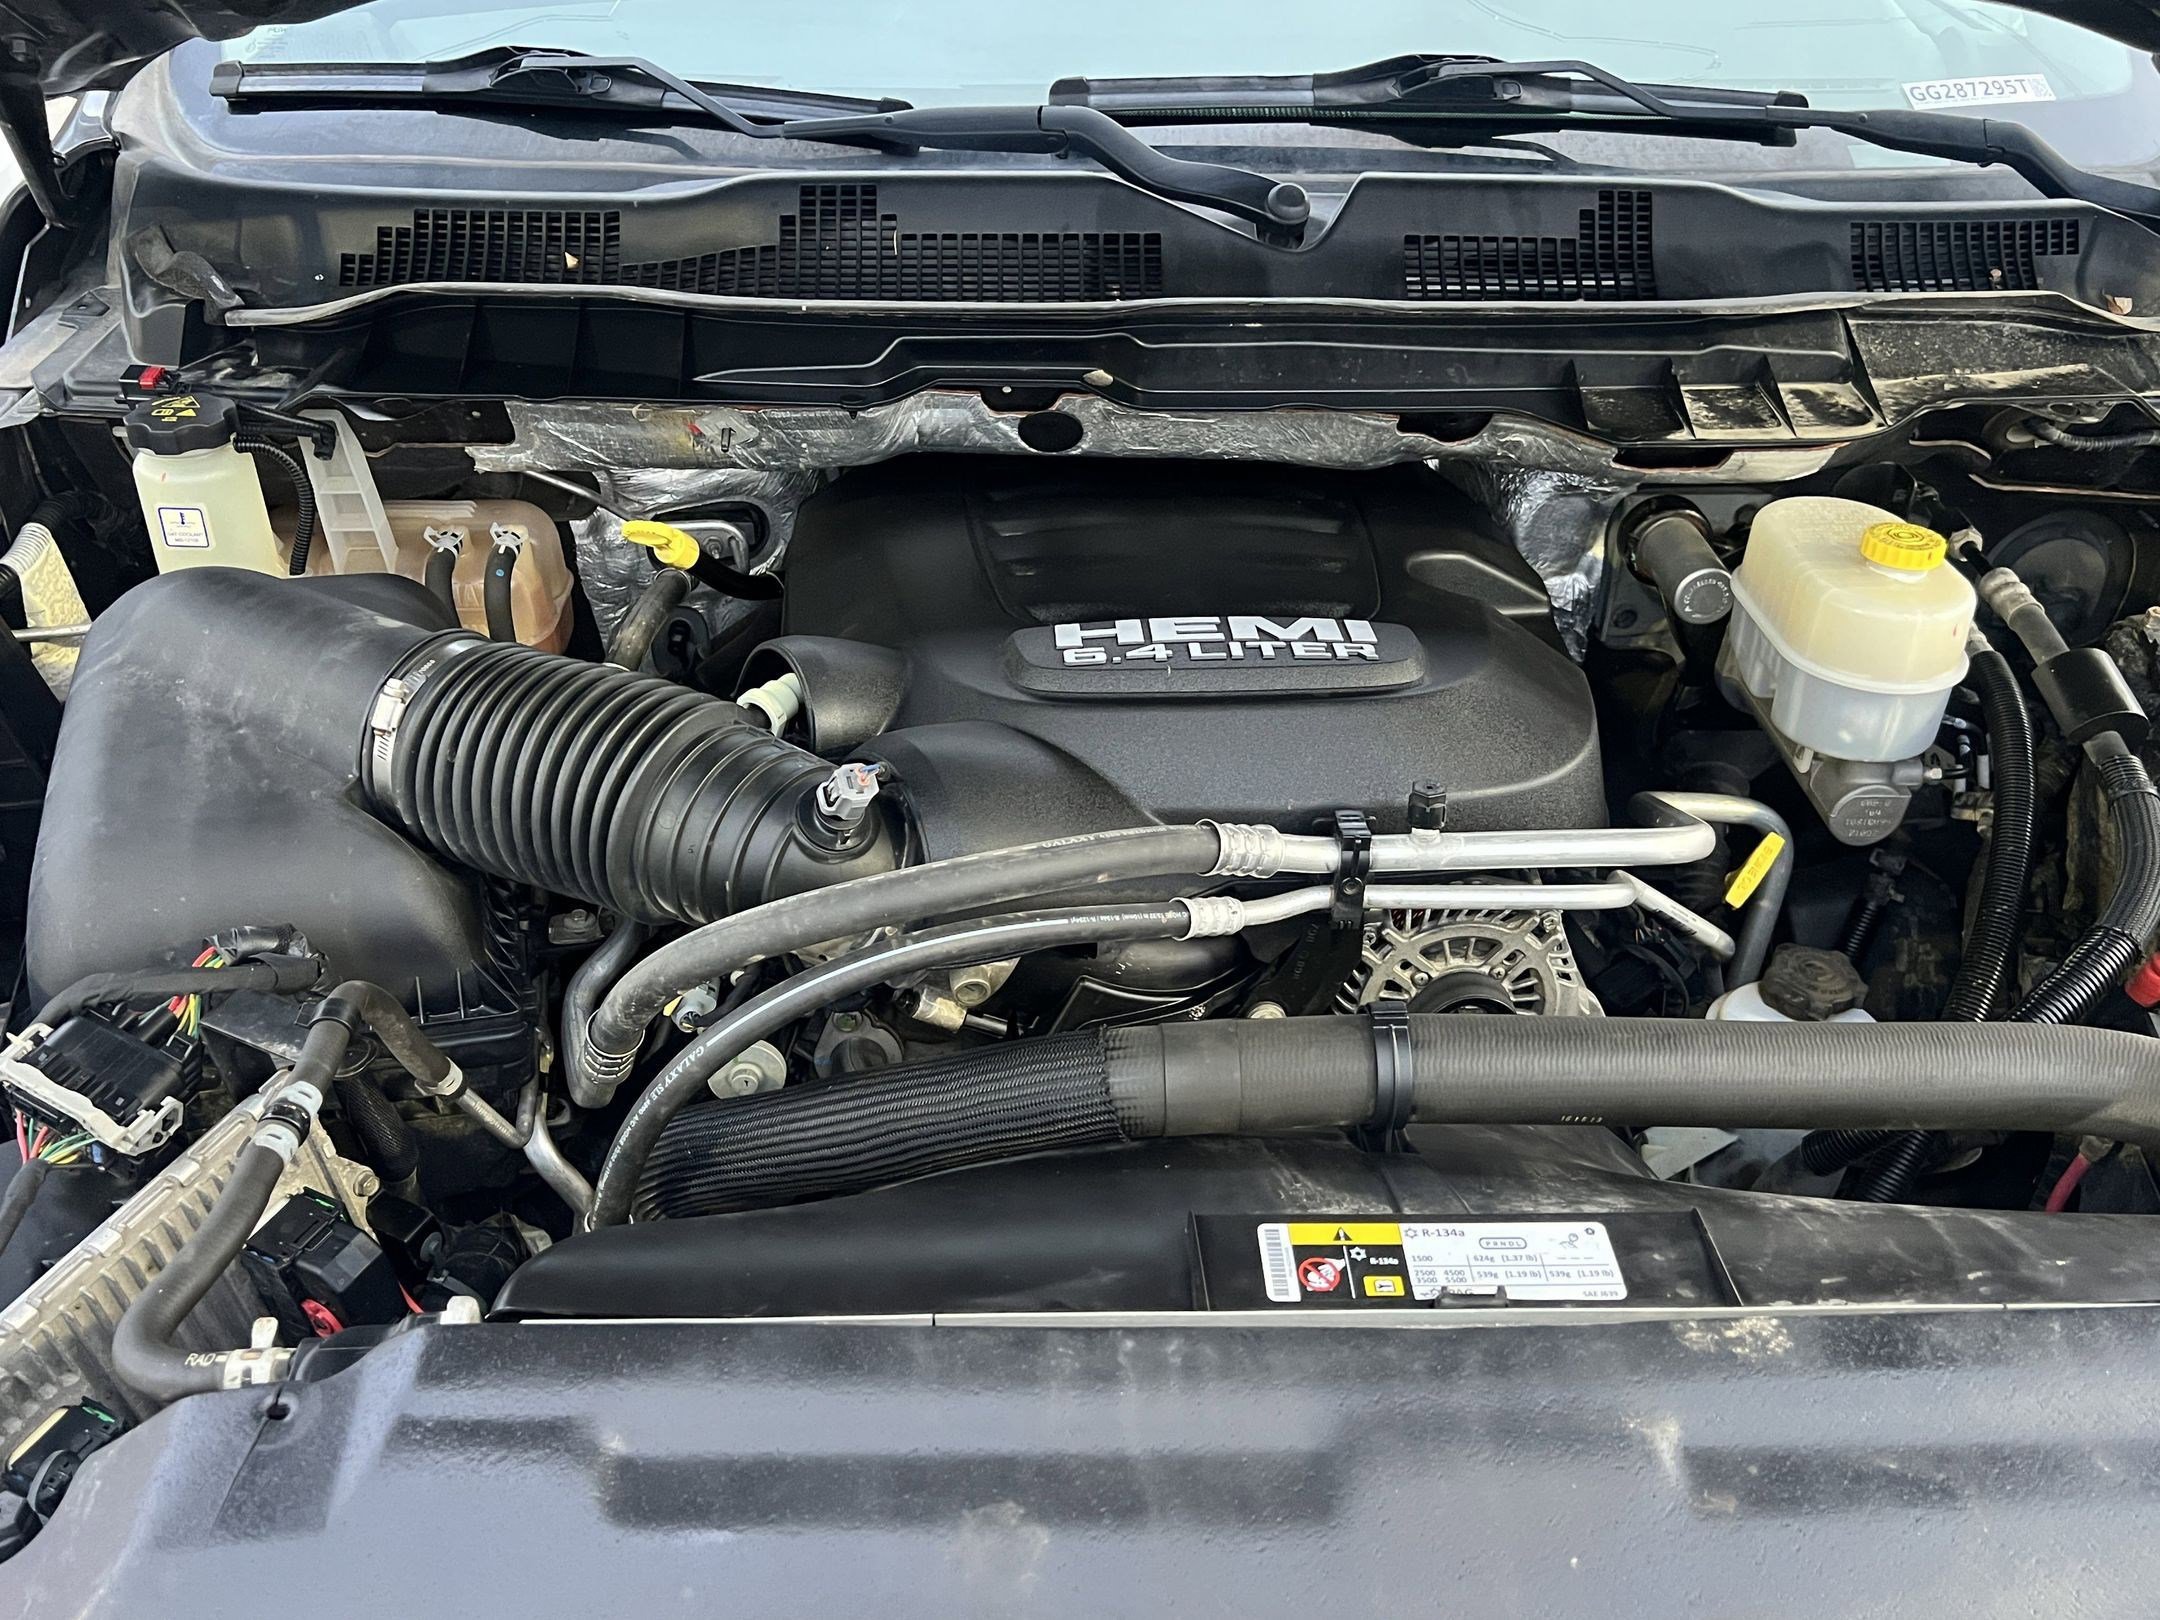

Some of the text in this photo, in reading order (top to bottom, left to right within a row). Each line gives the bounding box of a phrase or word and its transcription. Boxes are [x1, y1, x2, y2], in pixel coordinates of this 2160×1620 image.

[1909, 79, 2029, 102] GG287295T
[1054, 615, 1378, 650] HEMI
[1062, 641, 1379, 667] 6.4 LITER
[664, 1045, 705, 1088] GALAXY
[649, 1083, 665, 1101] SLE
[1421, 1228, 1466, 1238] R-134a
[1473, 1254, 1495, 1264] 624g
[1501, 1254, 1523, 1263] (1.37
[1525, 1254, 1538, 1262] lb)
[1445, 1276, 1468, 1284] 5500
[1476, 1270, 1542, 1280] 539g (1.19 lb)
[1548, 1269, 1615, 1279] 539g (1.19 lb)
[184, 1352, 217, 1367] RAD
